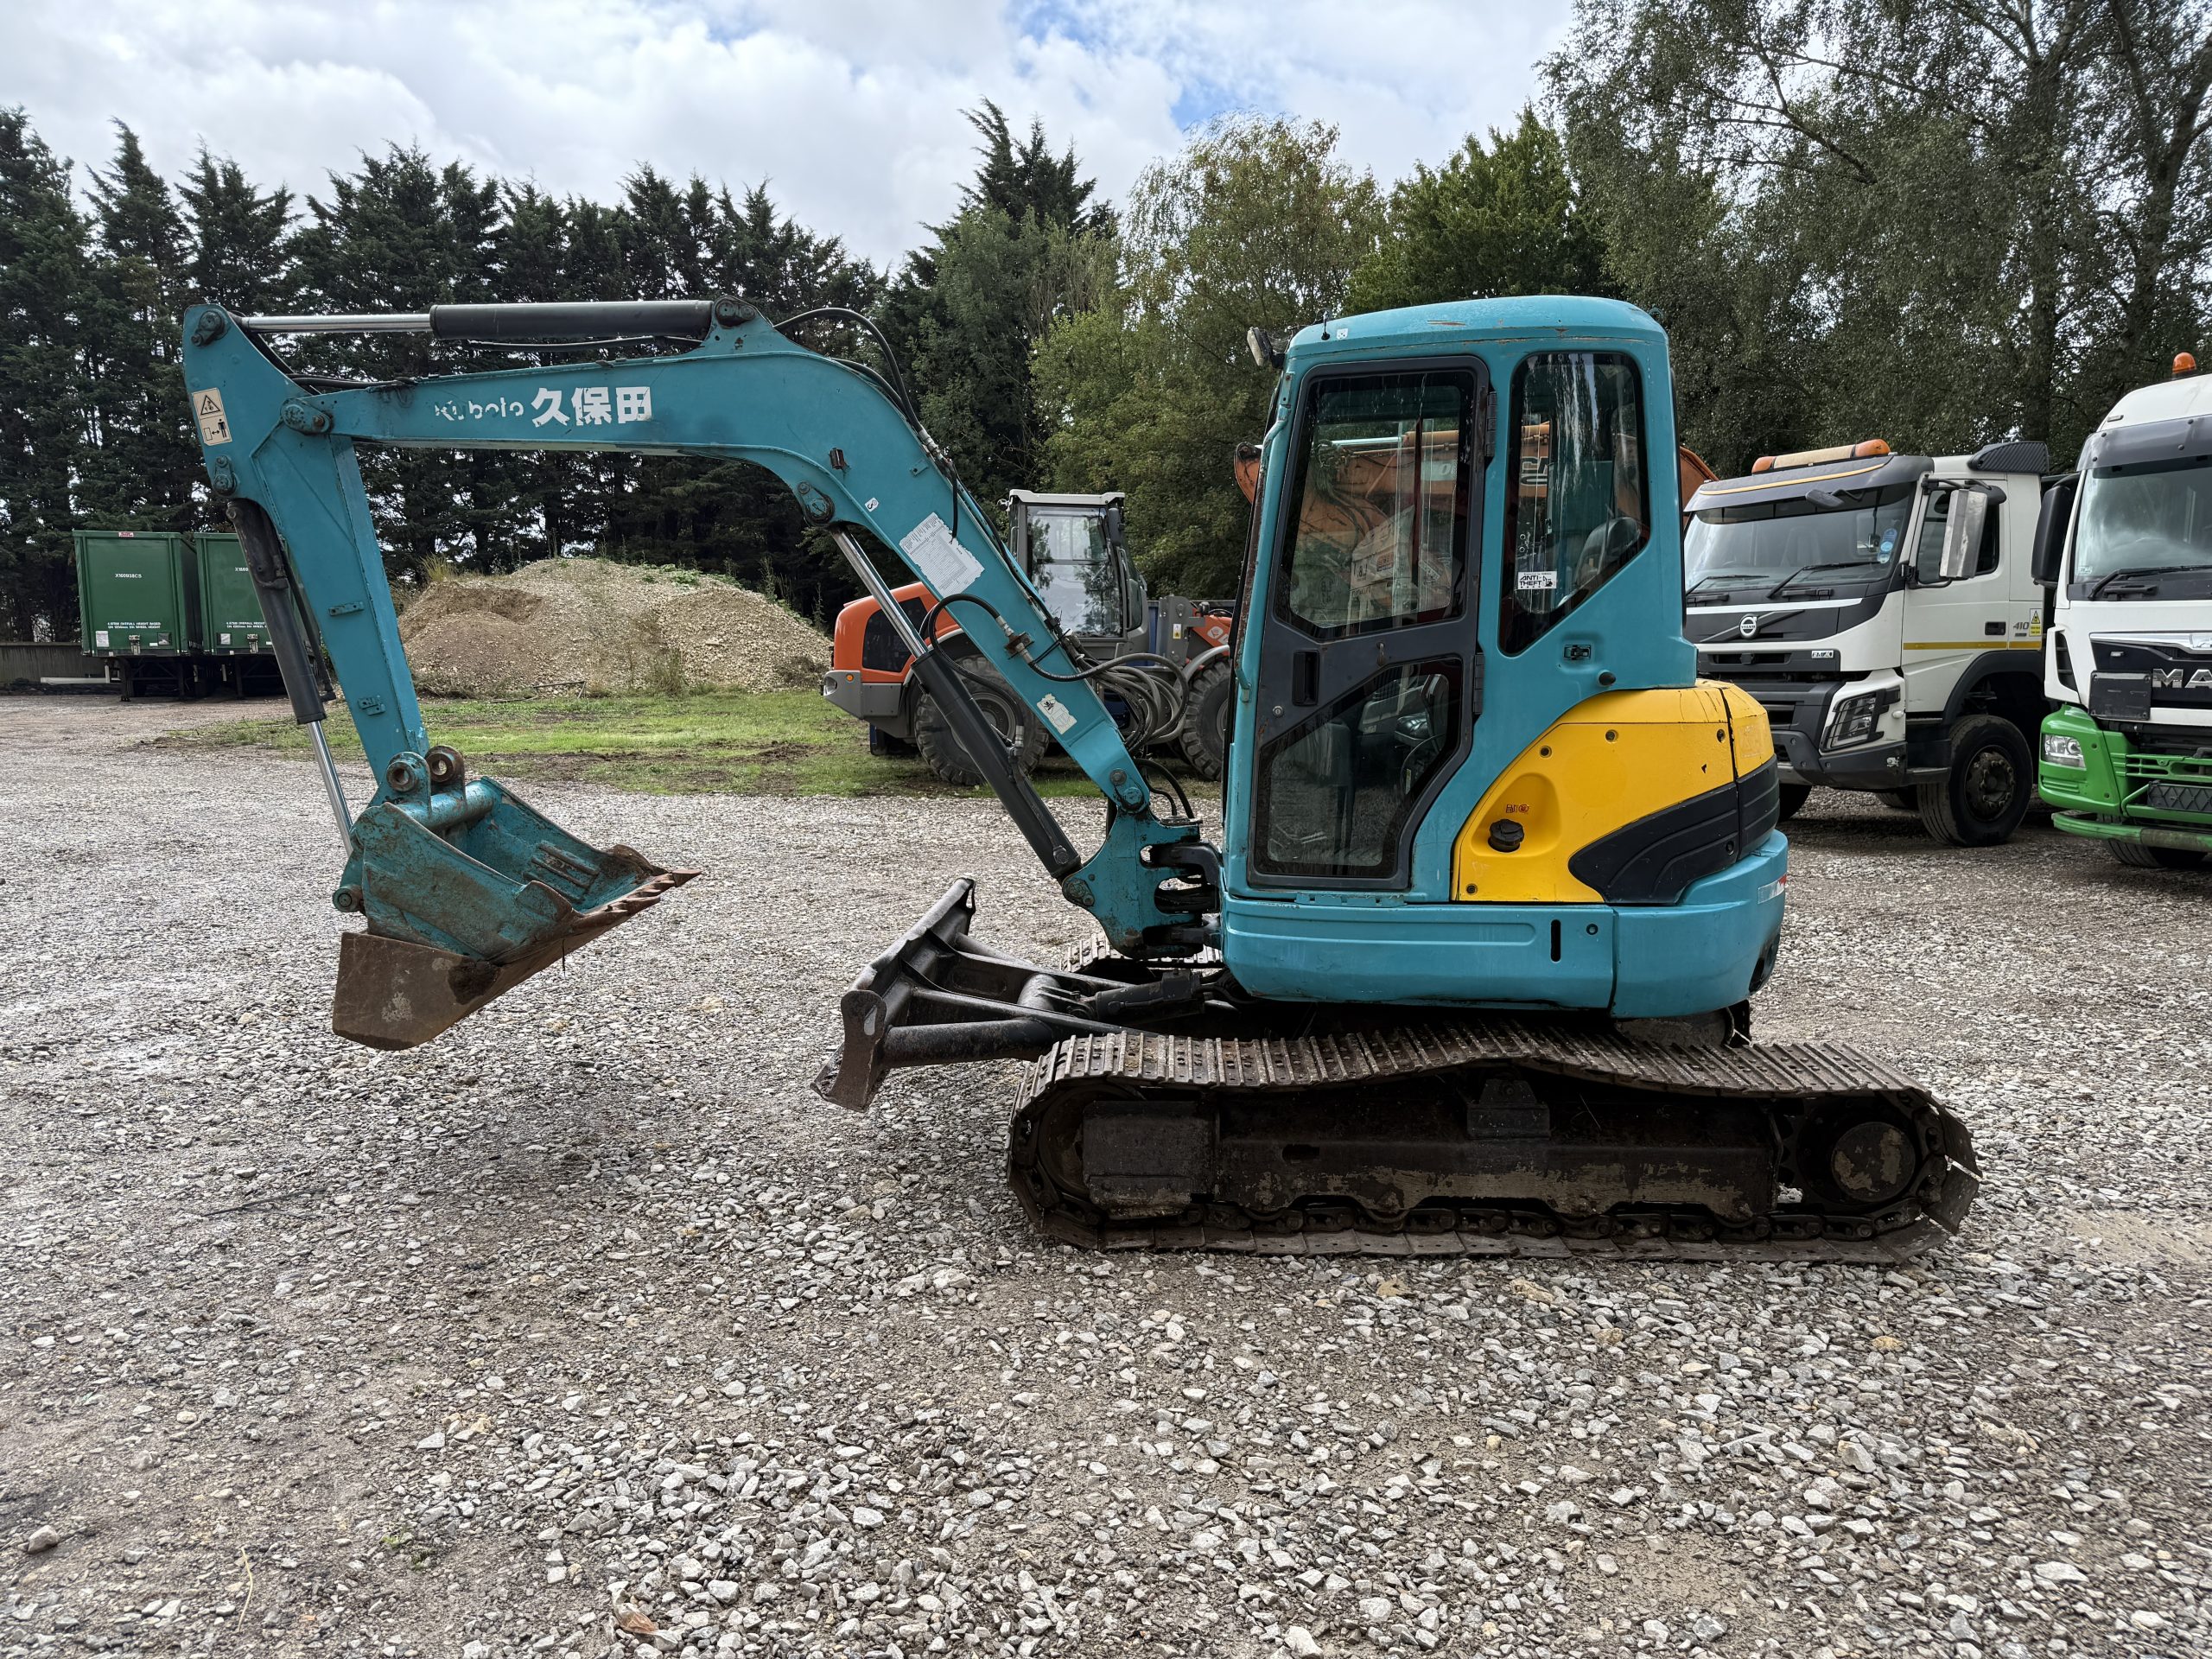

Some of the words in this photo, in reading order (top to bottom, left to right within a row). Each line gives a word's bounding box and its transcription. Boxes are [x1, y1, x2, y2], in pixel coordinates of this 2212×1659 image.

[531, 386, 652, 428] 久保田
[2012, 621, 2030, 630] 410
